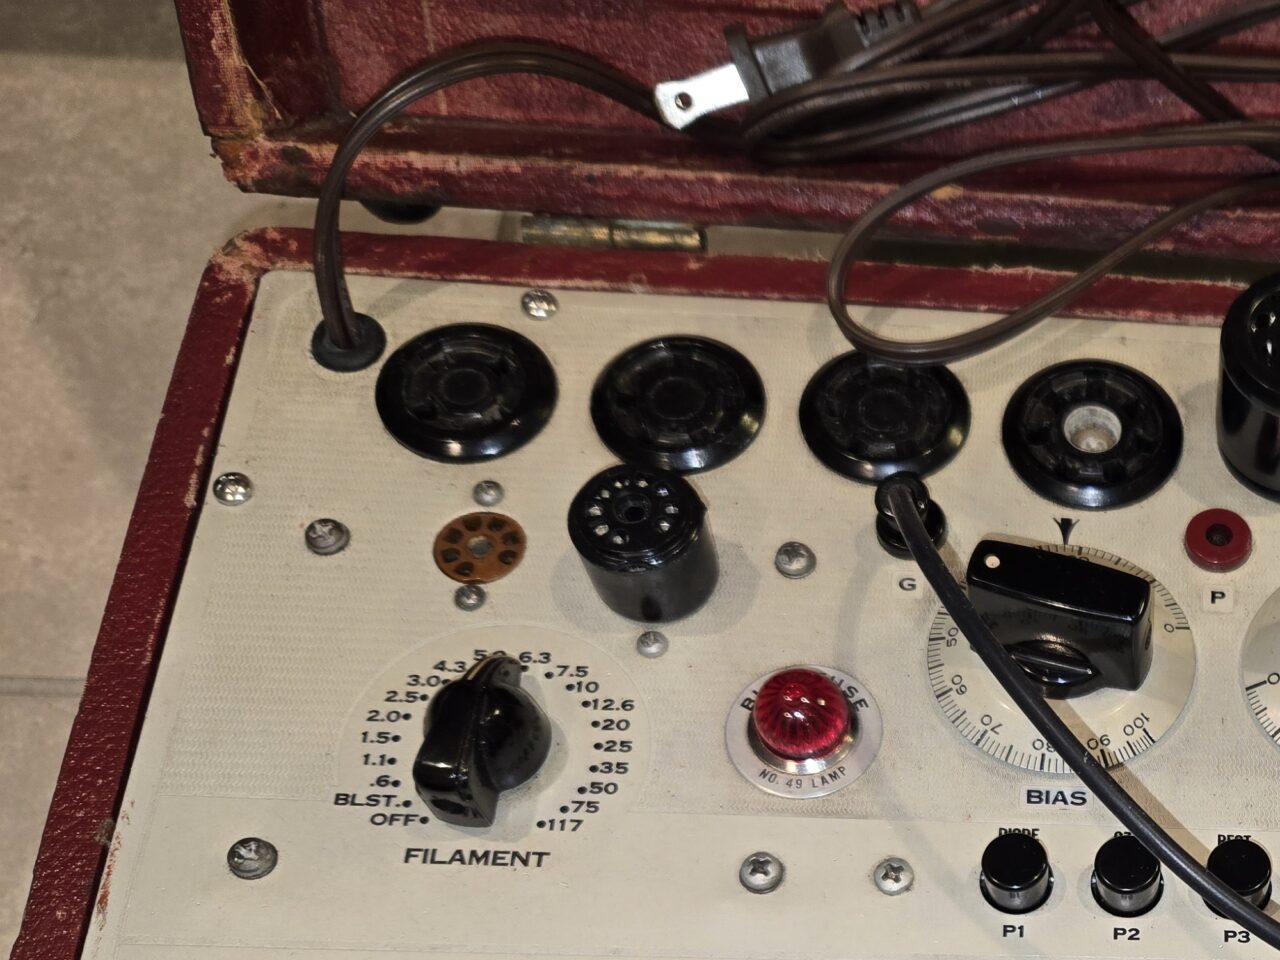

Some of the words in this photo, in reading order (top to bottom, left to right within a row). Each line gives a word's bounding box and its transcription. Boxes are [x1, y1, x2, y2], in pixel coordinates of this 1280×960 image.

[899, 578, 917, 591] G
[1210, 591, 1226, 604] P
[519, 652, 551, 664] 6.3
[556, 666, 589, 678] 7.5
[407, 675, 440, 687] 3.0
[576, 681, 599, 693] 10
[384, 691, 419, 703] 2.5
[592, 699, 635, 711] 12.6
[366, 710, 401, 722] 2.0
[601, 719, 630, 731] 20
[361, 732, 391, 743] 1.5
[603, 740, 633, 752] 25
[363, 754, 388, 765] 1.1
[599, 762, 629, 774] 35
[370, 775, 391, 787] .6
[758, 768, 779, 784] NO.
[786, 778, 802, 789] 49
[812, 766, 846, 788] LAMP
[589, 782, 618, 794] 50
[334, 793, 401, 807] BLST.
[1026, 789, 1088, 806] BIAS
[571, 801, 599, 814] 75
[370, 813, 418, 826] OFF
[547, 819, 584, 832] 117
[403, 848, 551, 868] FILAMENT
[1002, 925, 1025, 938] P1
[1113, 928, 1141, 941] P2
[1224, 930, 1251, 943] P3
